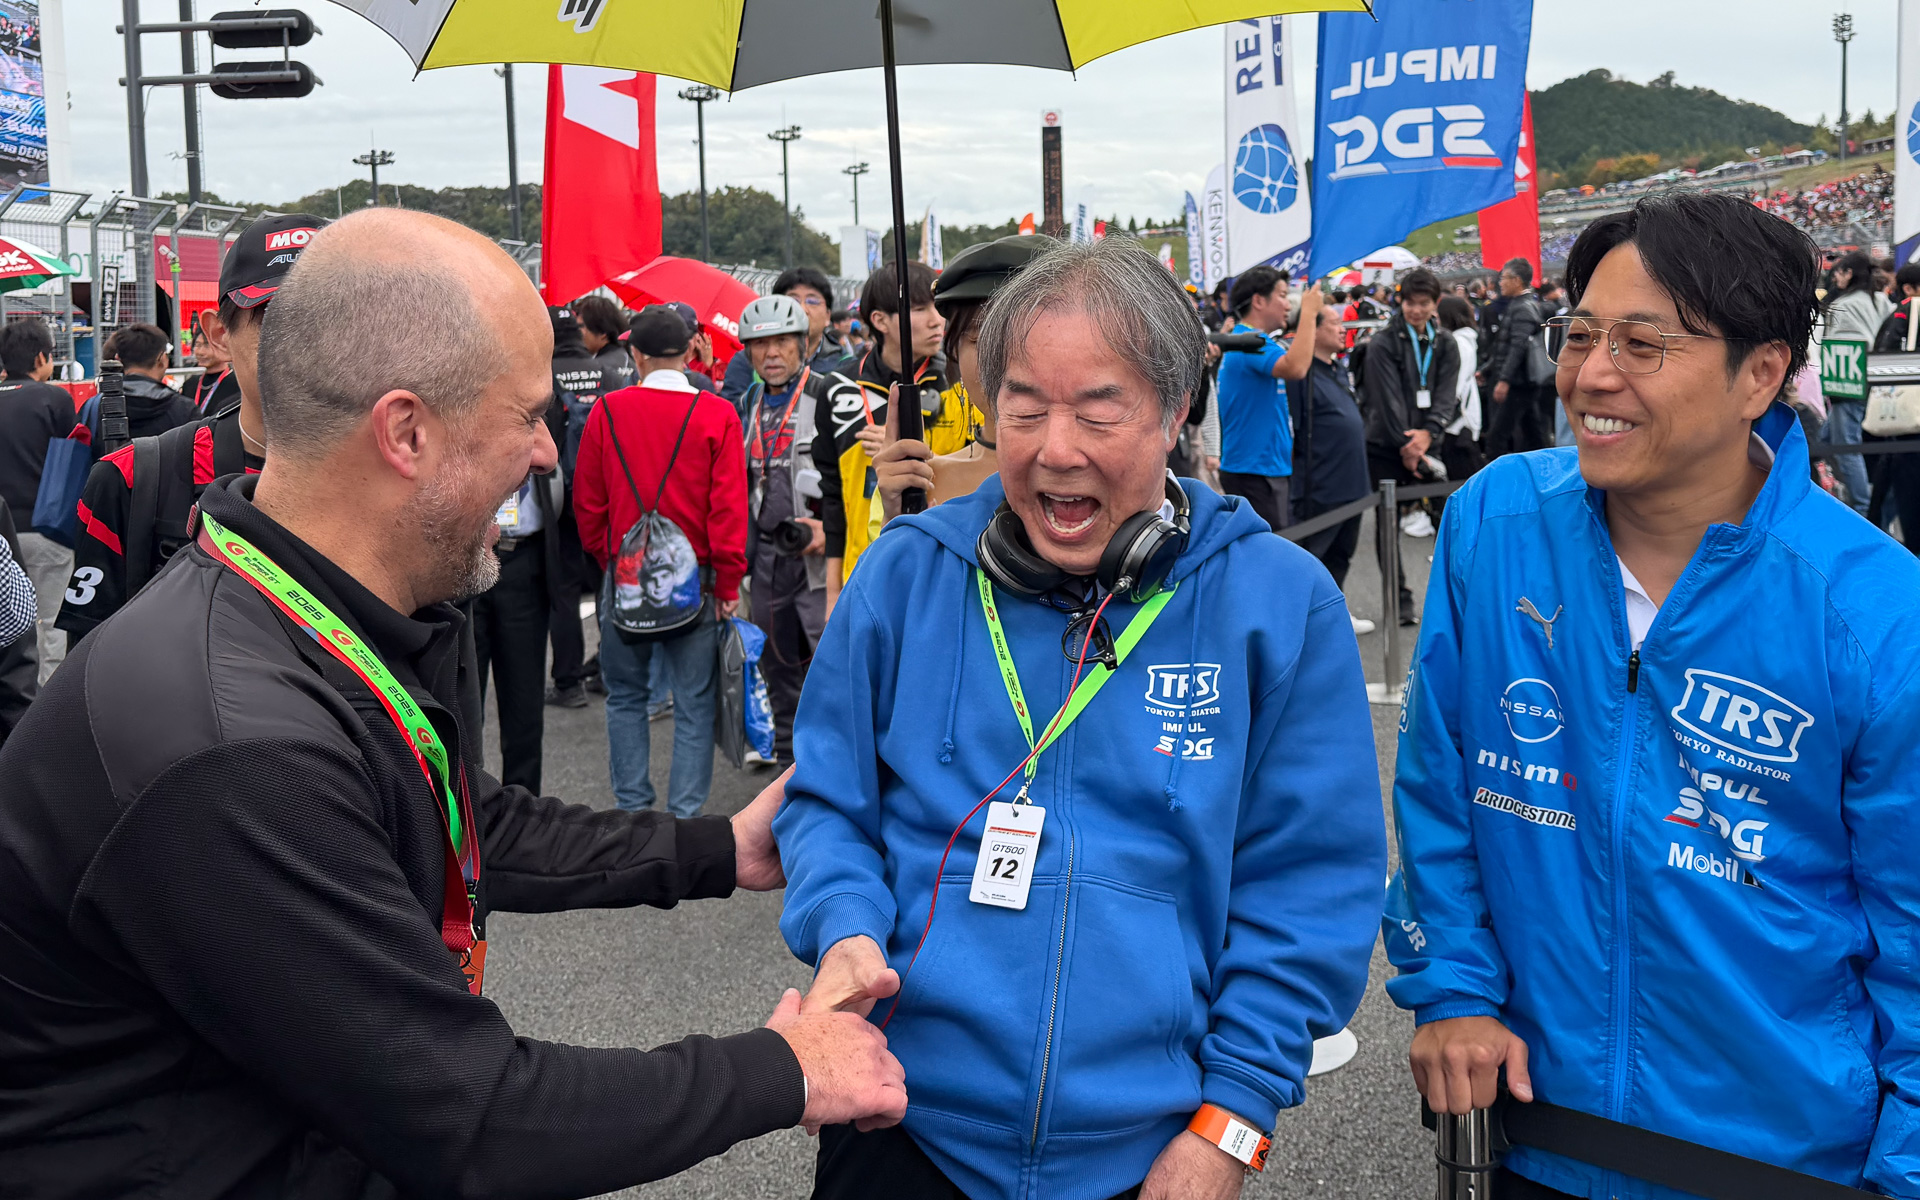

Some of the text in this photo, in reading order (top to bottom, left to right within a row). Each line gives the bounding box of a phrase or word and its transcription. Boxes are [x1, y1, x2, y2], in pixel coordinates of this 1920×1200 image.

[1207, 188, 1223, 284] KENWOO
[1822, 344, 1863, 381] NTK
[64, 566, 104, 606] 3
[286, 589, 326, 621] 2025
[388, 685, 416, 718] 2025
[1144, 705, 1221, 718] TOKYO RDIATOR
[1500, 697, 1565, 723] NISSAN
[1698, 681, 1793, 748] TRS
[1477, 748, 1578, 792] nismo
[1669, 726, 1792, 783] OKYO RADIATOR
[1475, 788, 1576, 830] BRIDGESTONE
[992, 843, 1025, 855] GT500
[1667, 841, 1739, 883] Mobil
[990, 857, 1019, 880] 12
